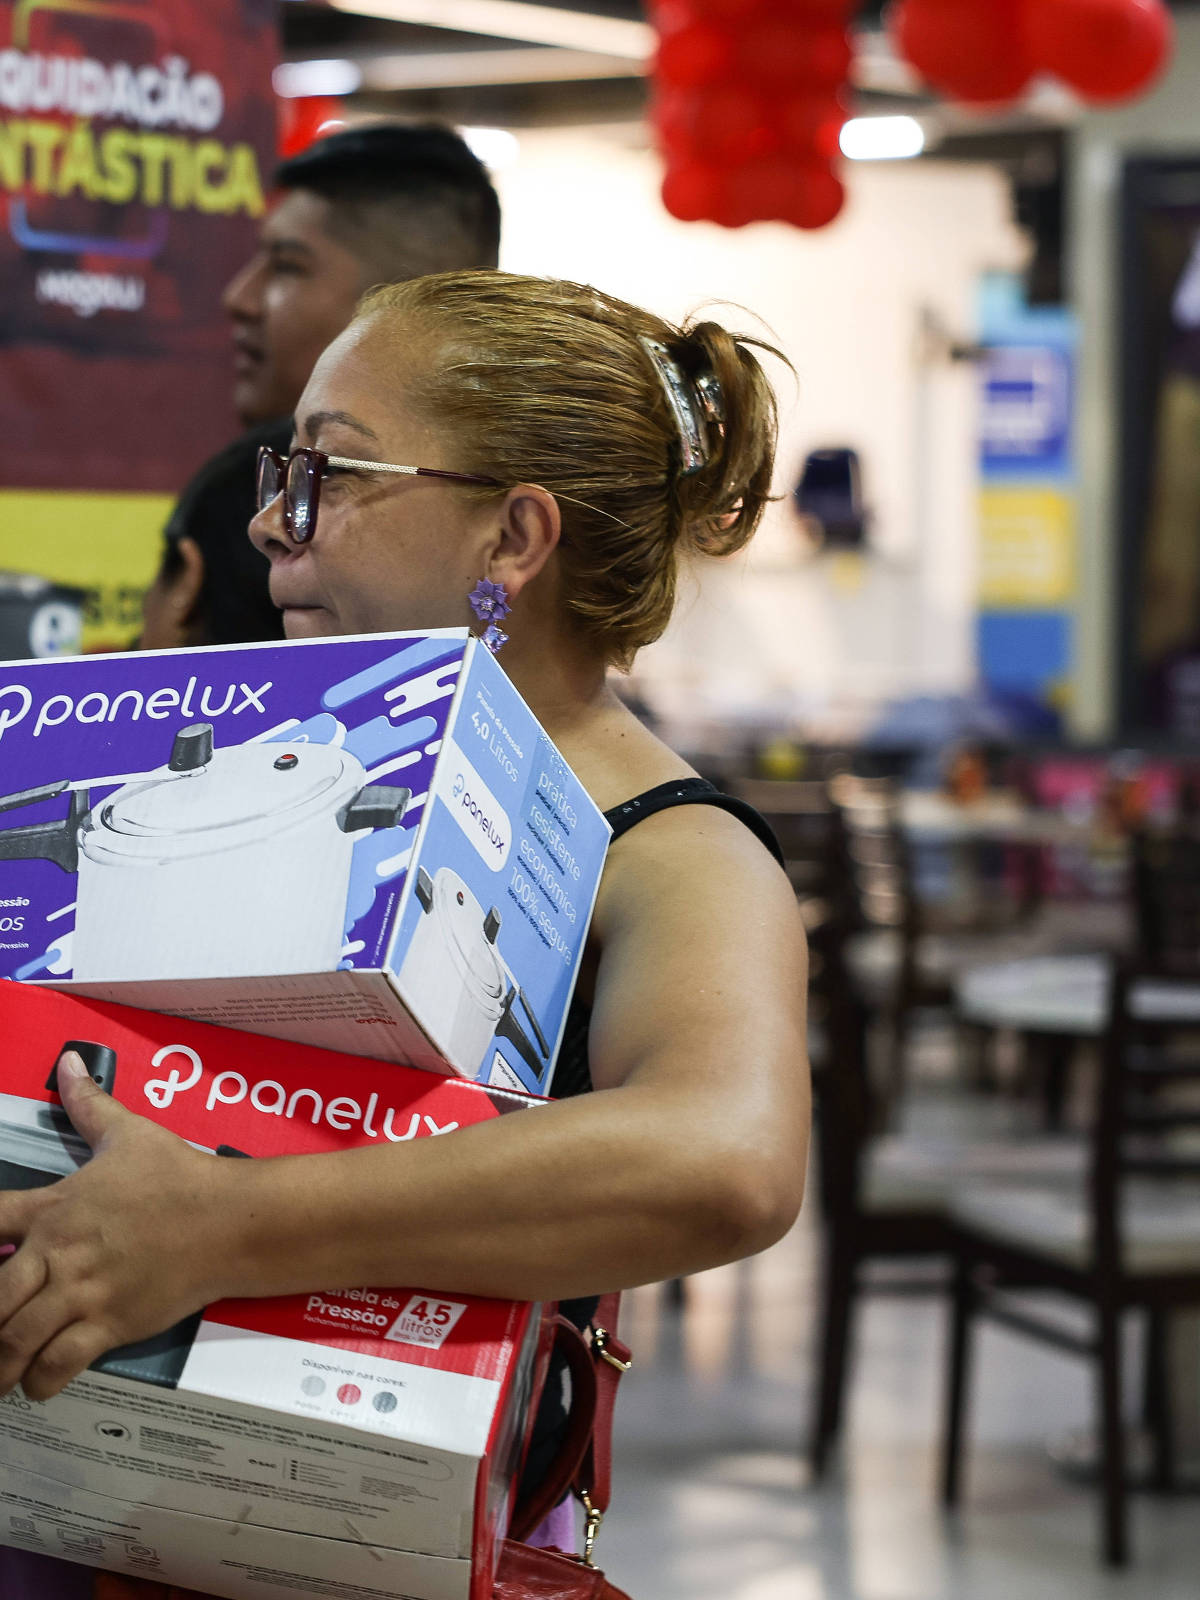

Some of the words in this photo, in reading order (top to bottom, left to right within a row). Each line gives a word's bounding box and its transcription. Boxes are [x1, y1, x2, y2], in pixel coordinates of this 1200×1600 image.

[33, 676, 273, 737] panelux
[472, 712, 490, 740] 4,0
[489, 734, 519, 782] Litros
[462, 793, 504, 854] panelux
[538, 771, 577, 828] prática
[529, 805, 582, 880] resistente
[511, 866, 537, 910] 100%
[538, 910, 573, 966] segura
[306, 1296, 388, 1327] Pressão
[381, 1296, 400, 1309] de
[400, 1317, 443, 1338] litros
[301, 1358, 355, 1377] Disponível
[356, 1371, 374, 1381] nas
